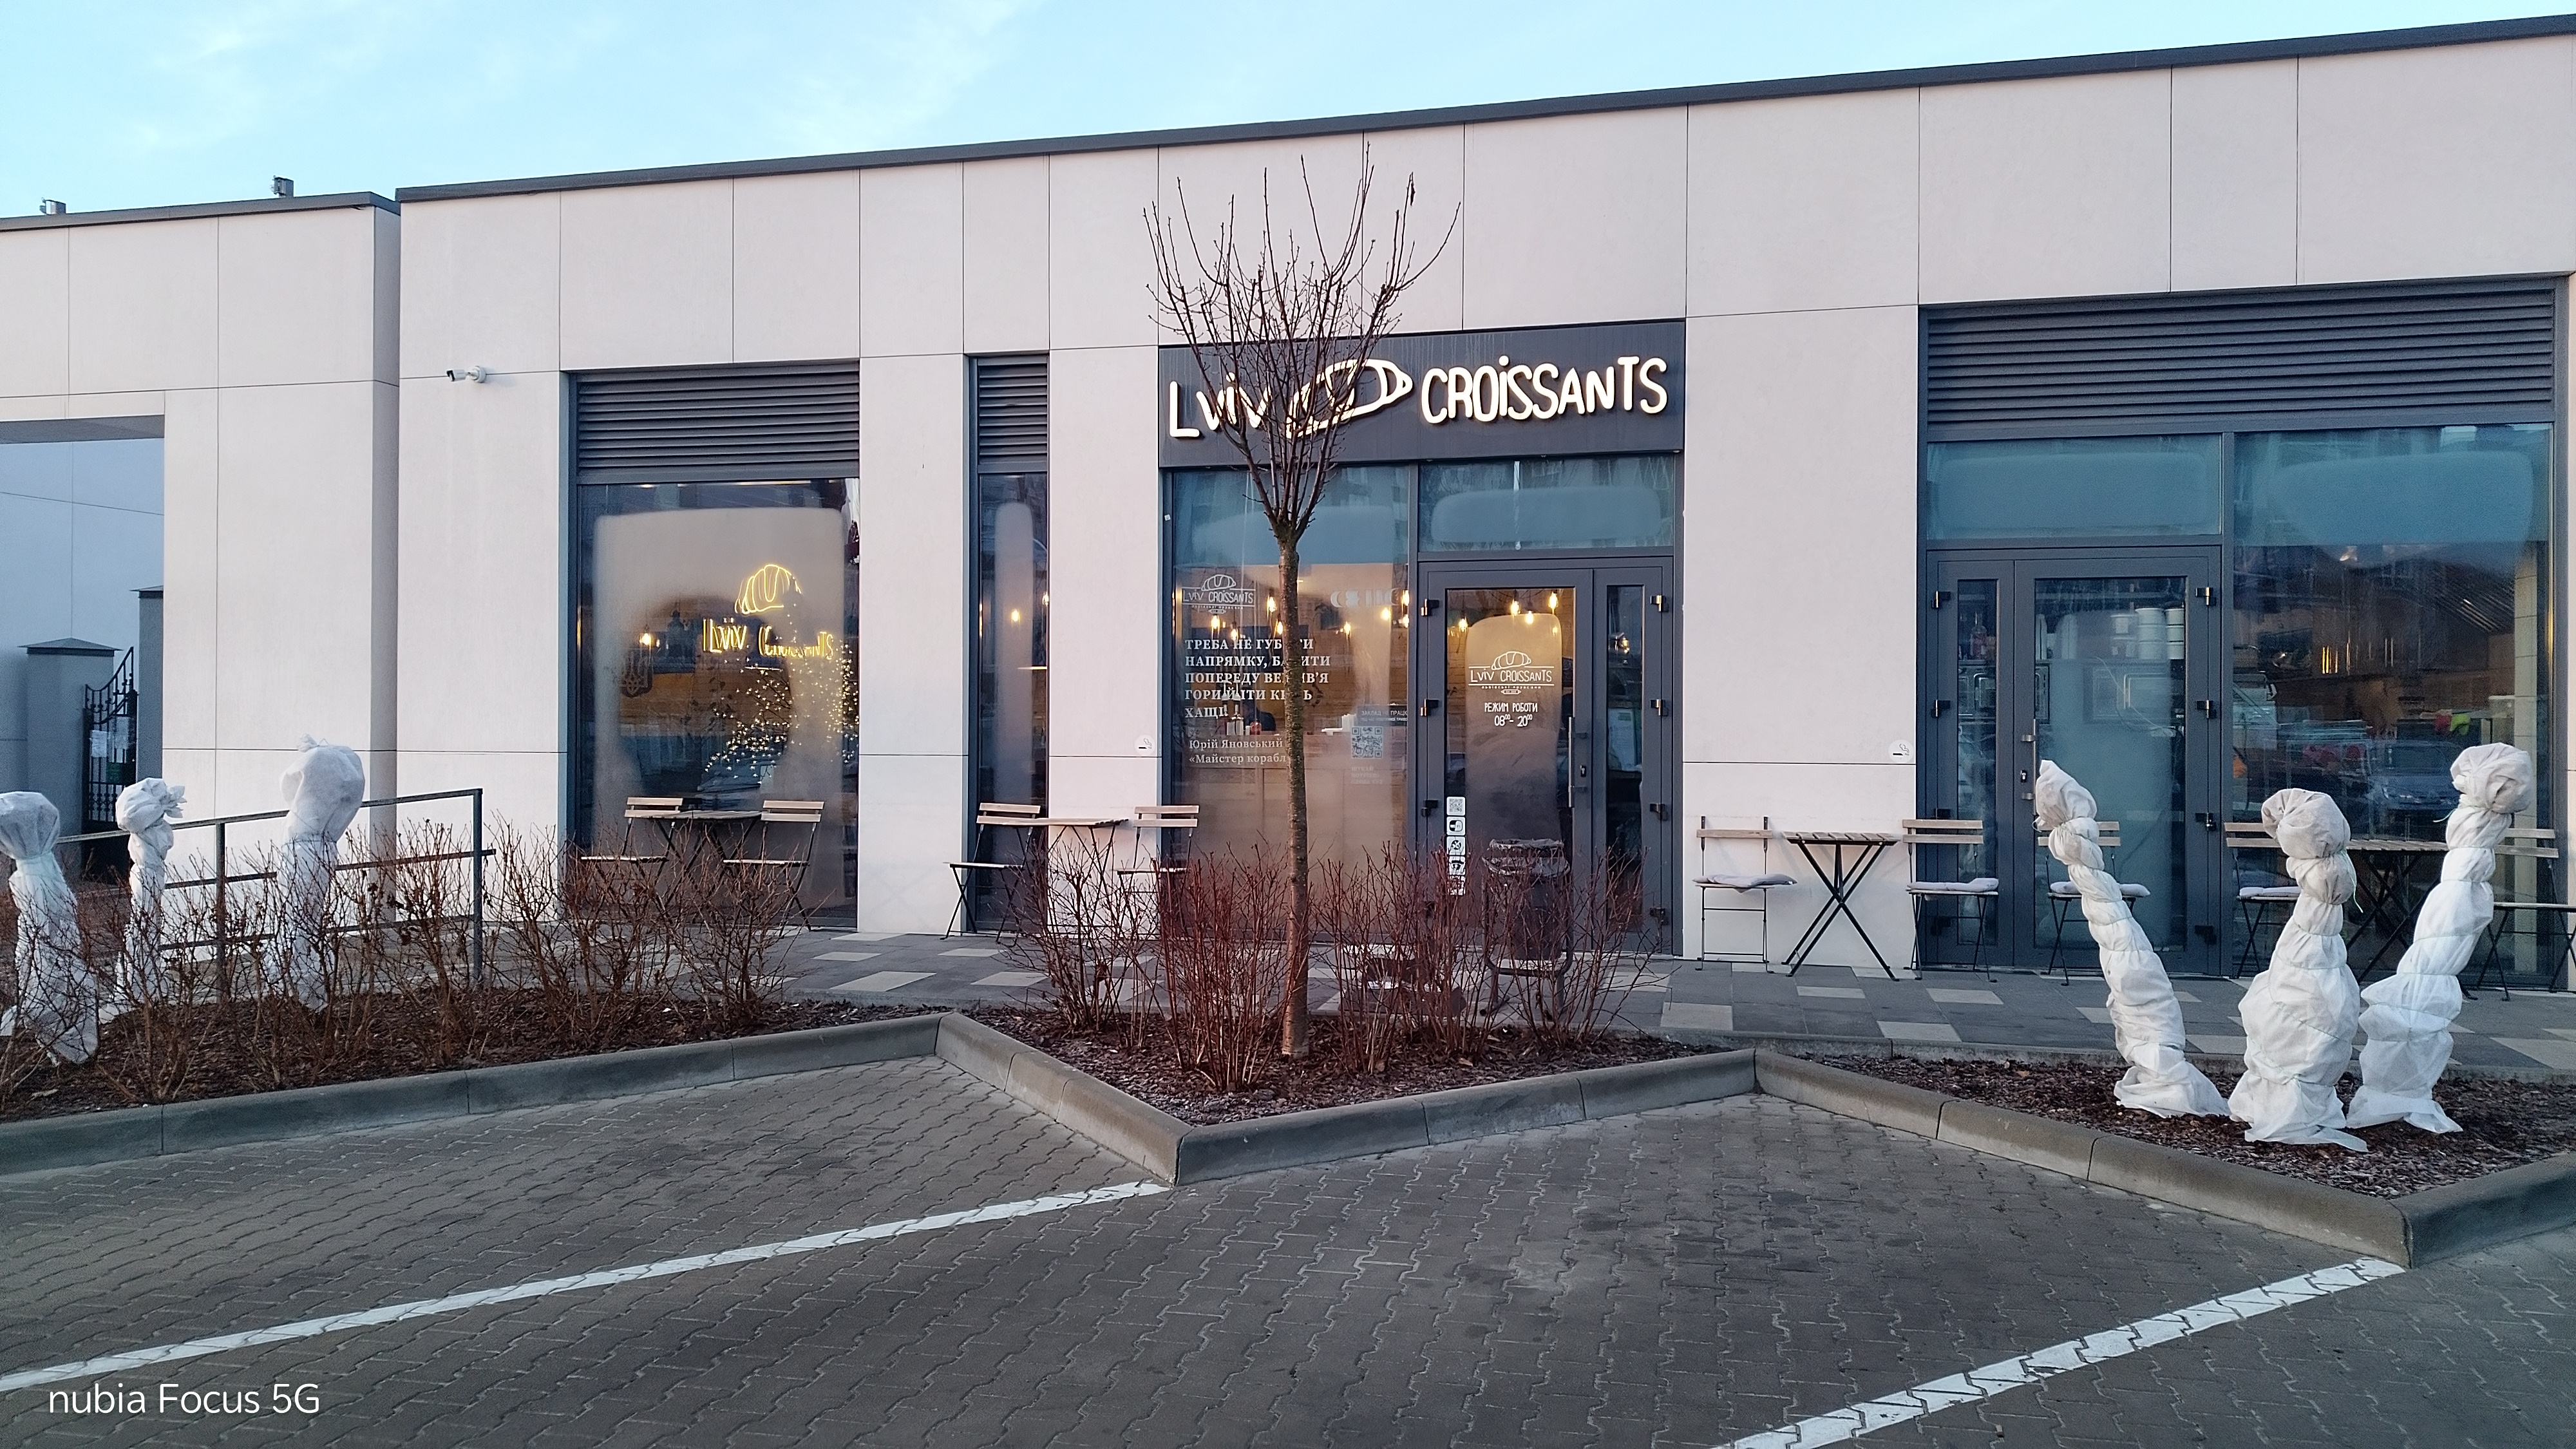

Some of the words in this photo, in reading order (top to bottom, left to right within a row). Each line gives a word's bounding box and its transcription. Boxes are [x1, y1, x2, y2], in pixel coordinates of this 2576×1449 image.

[1185, 639, 1229, 650] ТРЕБА
[1233, 639, 1252, 650] НЕ
[1256, 639, 1314, 650] ГУБИ
[1185, 656, 1267, 669] НАПРЯМКУ,
[1272, 656, 1331, 667] БИТИ
[1185, 672, 1260, 685] ПОПЕРЕДУ
[1185, 689, 1222, 700] ГОРИ
[1484, 702, 1509, 713] РЕЖИМ
[1512, 702, 1539, 713] РОБОТИ
[1189, 739, 1218, 752] Юрій
[1220, 738, 1283, 748] Яновський
[1246, 753, 1287, 765] корабл
